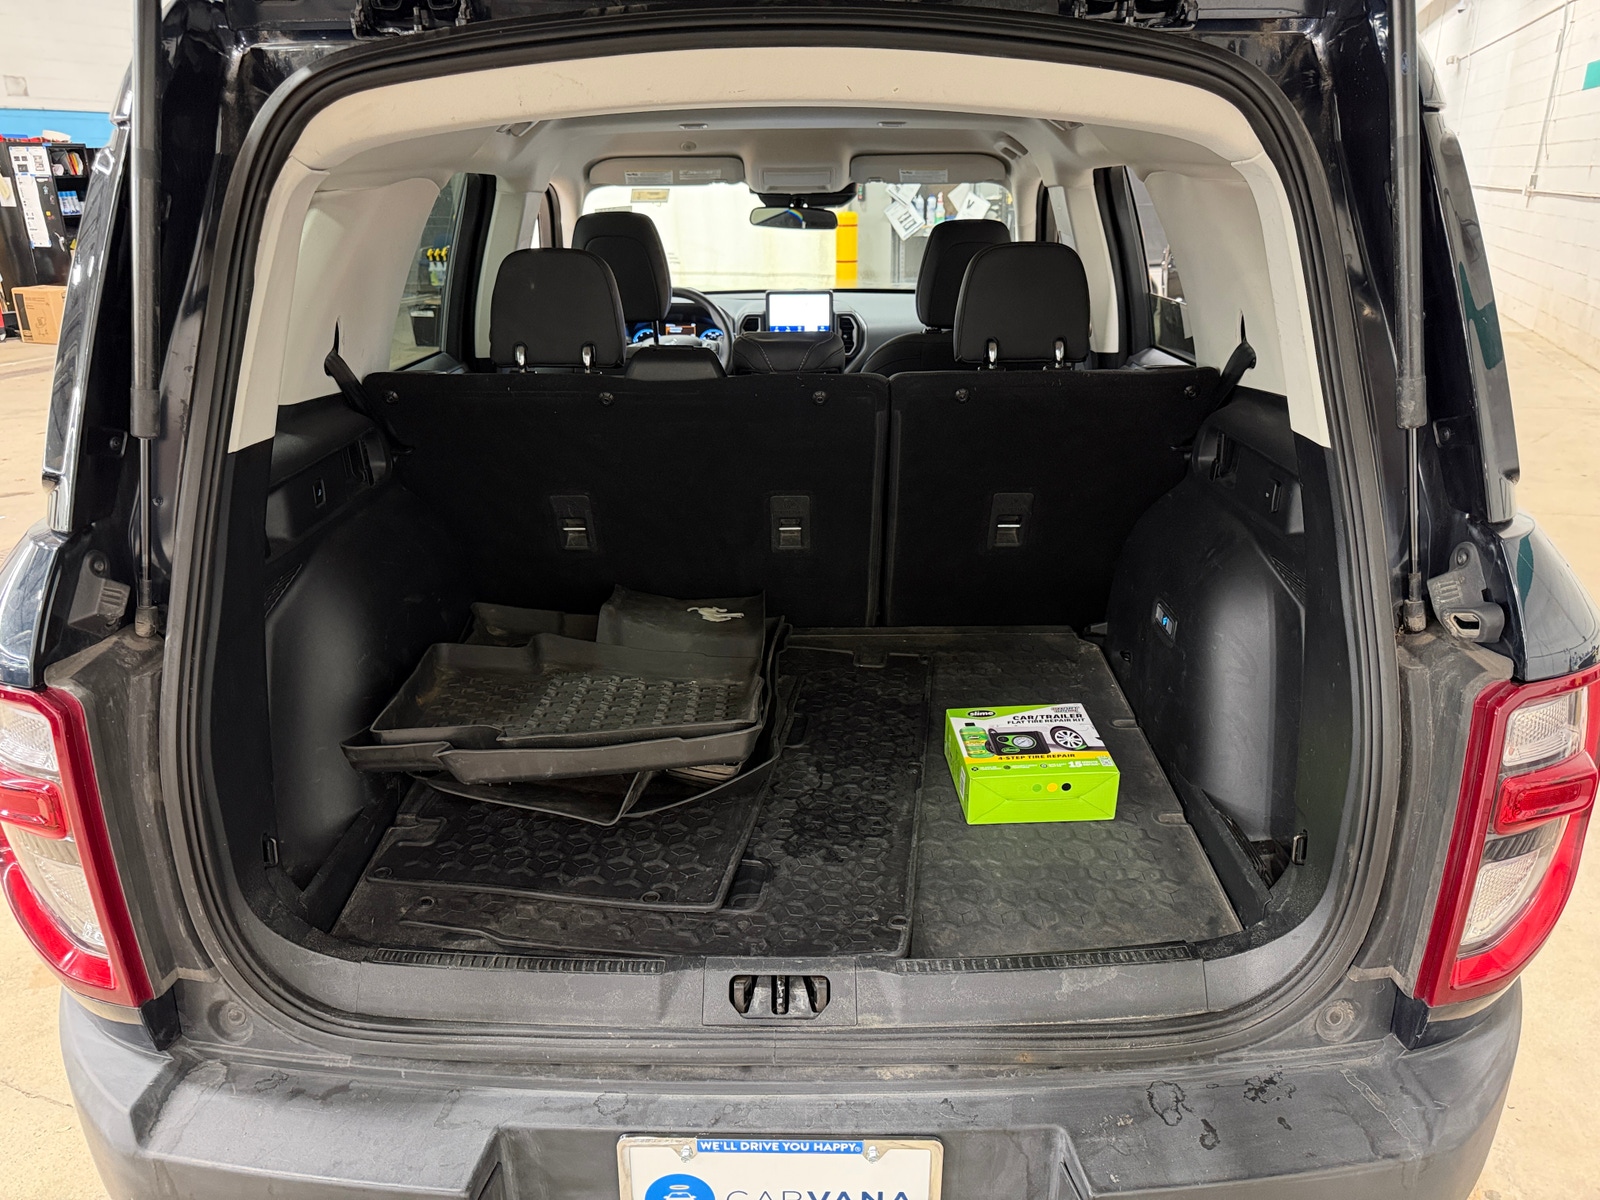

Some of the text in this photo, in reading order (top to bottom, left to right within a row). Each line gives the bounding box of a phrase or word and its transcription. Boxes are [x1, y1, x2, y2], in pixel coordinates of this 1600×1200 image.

[700, 1141, 737, 1151] WE'LL
[740, 1142, 780, 1151] DRIVE
[782, 1142, 810, 1152] YOU
